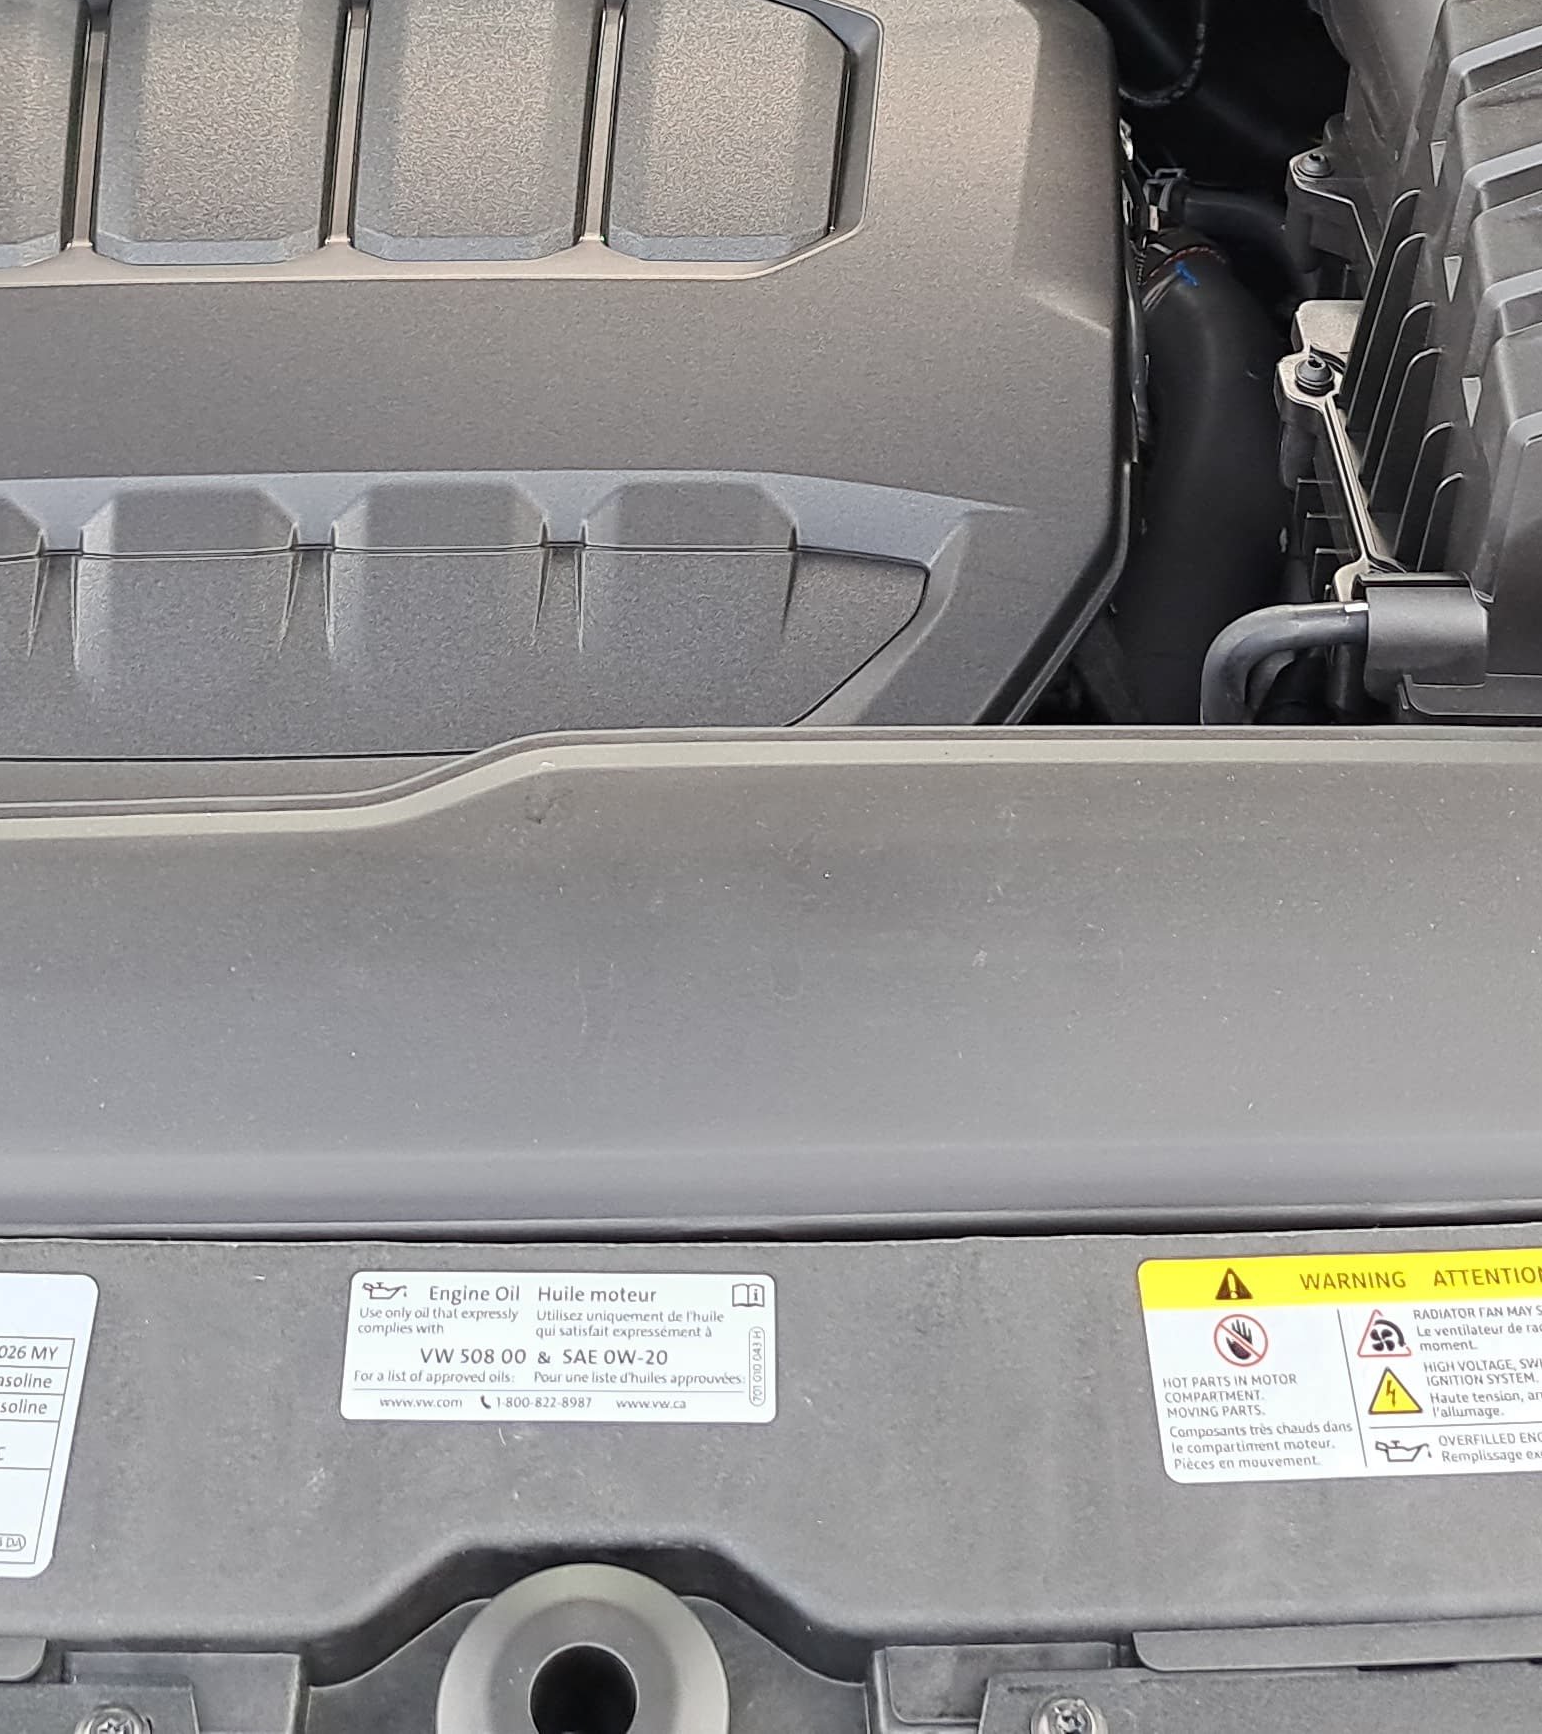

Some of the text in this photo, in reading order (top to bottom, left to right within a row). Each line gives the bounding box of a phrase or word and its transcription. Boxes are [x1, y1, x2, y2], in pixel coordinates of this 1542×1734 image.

[1299, 1271, 1406, 1290] WARNING
[429, 1285, 519, 1306] Engine Oil
[538, 1286, 656, 1303] Huile moteur
[360, 1307, 519, 1322] Use only oil that expressly
[537, 1309, 724, 1325] Utilisez uniquement de l'huile
[1413, 1308, 1476, 1320] RADIATOR
[1479, 1307, 1503, 1318] FAN
[1507, 1306, 1532, 1316] MAY
[358, 1322, 444, 1337] complies with
[536, 1325, 701, 1340] qui satisfait expressément
[1434, 1324, 1503, 1336] ventilateur
[1508, 1322, 1522, 1334] de
[31, 1346, 58, 1360] MY
[1420, 1340, 1478, 1352] moment.
[420, 1348, 668, 1365] VW 508 00 & SAE 0W-20
[1423, 1361, 1455, 1373] HIGH
[1457, 1359, 1517, 1372] VOLTAGE,
[354, 1370, 515, 1385] For list of approved oils:
[534, 1371, 746, 1387] Pour liste d'huiles approuvées:
[1163, 1373, 1297, 1388] HOT PARTS MOTOR
[1426, 1372, 1539, 1386] IGNITION SYSTEM.
[380, 1396, 686, 1409] www.vw.com 1-800-822-8987 www.vw.ca
[1165, 1389, 1265, 1403] COMPARTMENT.
[1430, 1393, 1469, 1404] Haute
[1472, 1391, 1524, 1403] tension,
[1167, 1404, 1266, 1418] MOVING PARTS.
[1432, 1406, 1504, 1419] l'allumage.
[1170, 1420, 1353, 1439] Composants très chauds dans
[1187, 1439, 1336, 1456] compartiment moteur.
[1438, 1433, 1516, 1447] OVERFILLED
[1174, 1455, 1321, 1470] Pièces mouvement.
[1441, 1450, 1522, 1464] Remplissage
